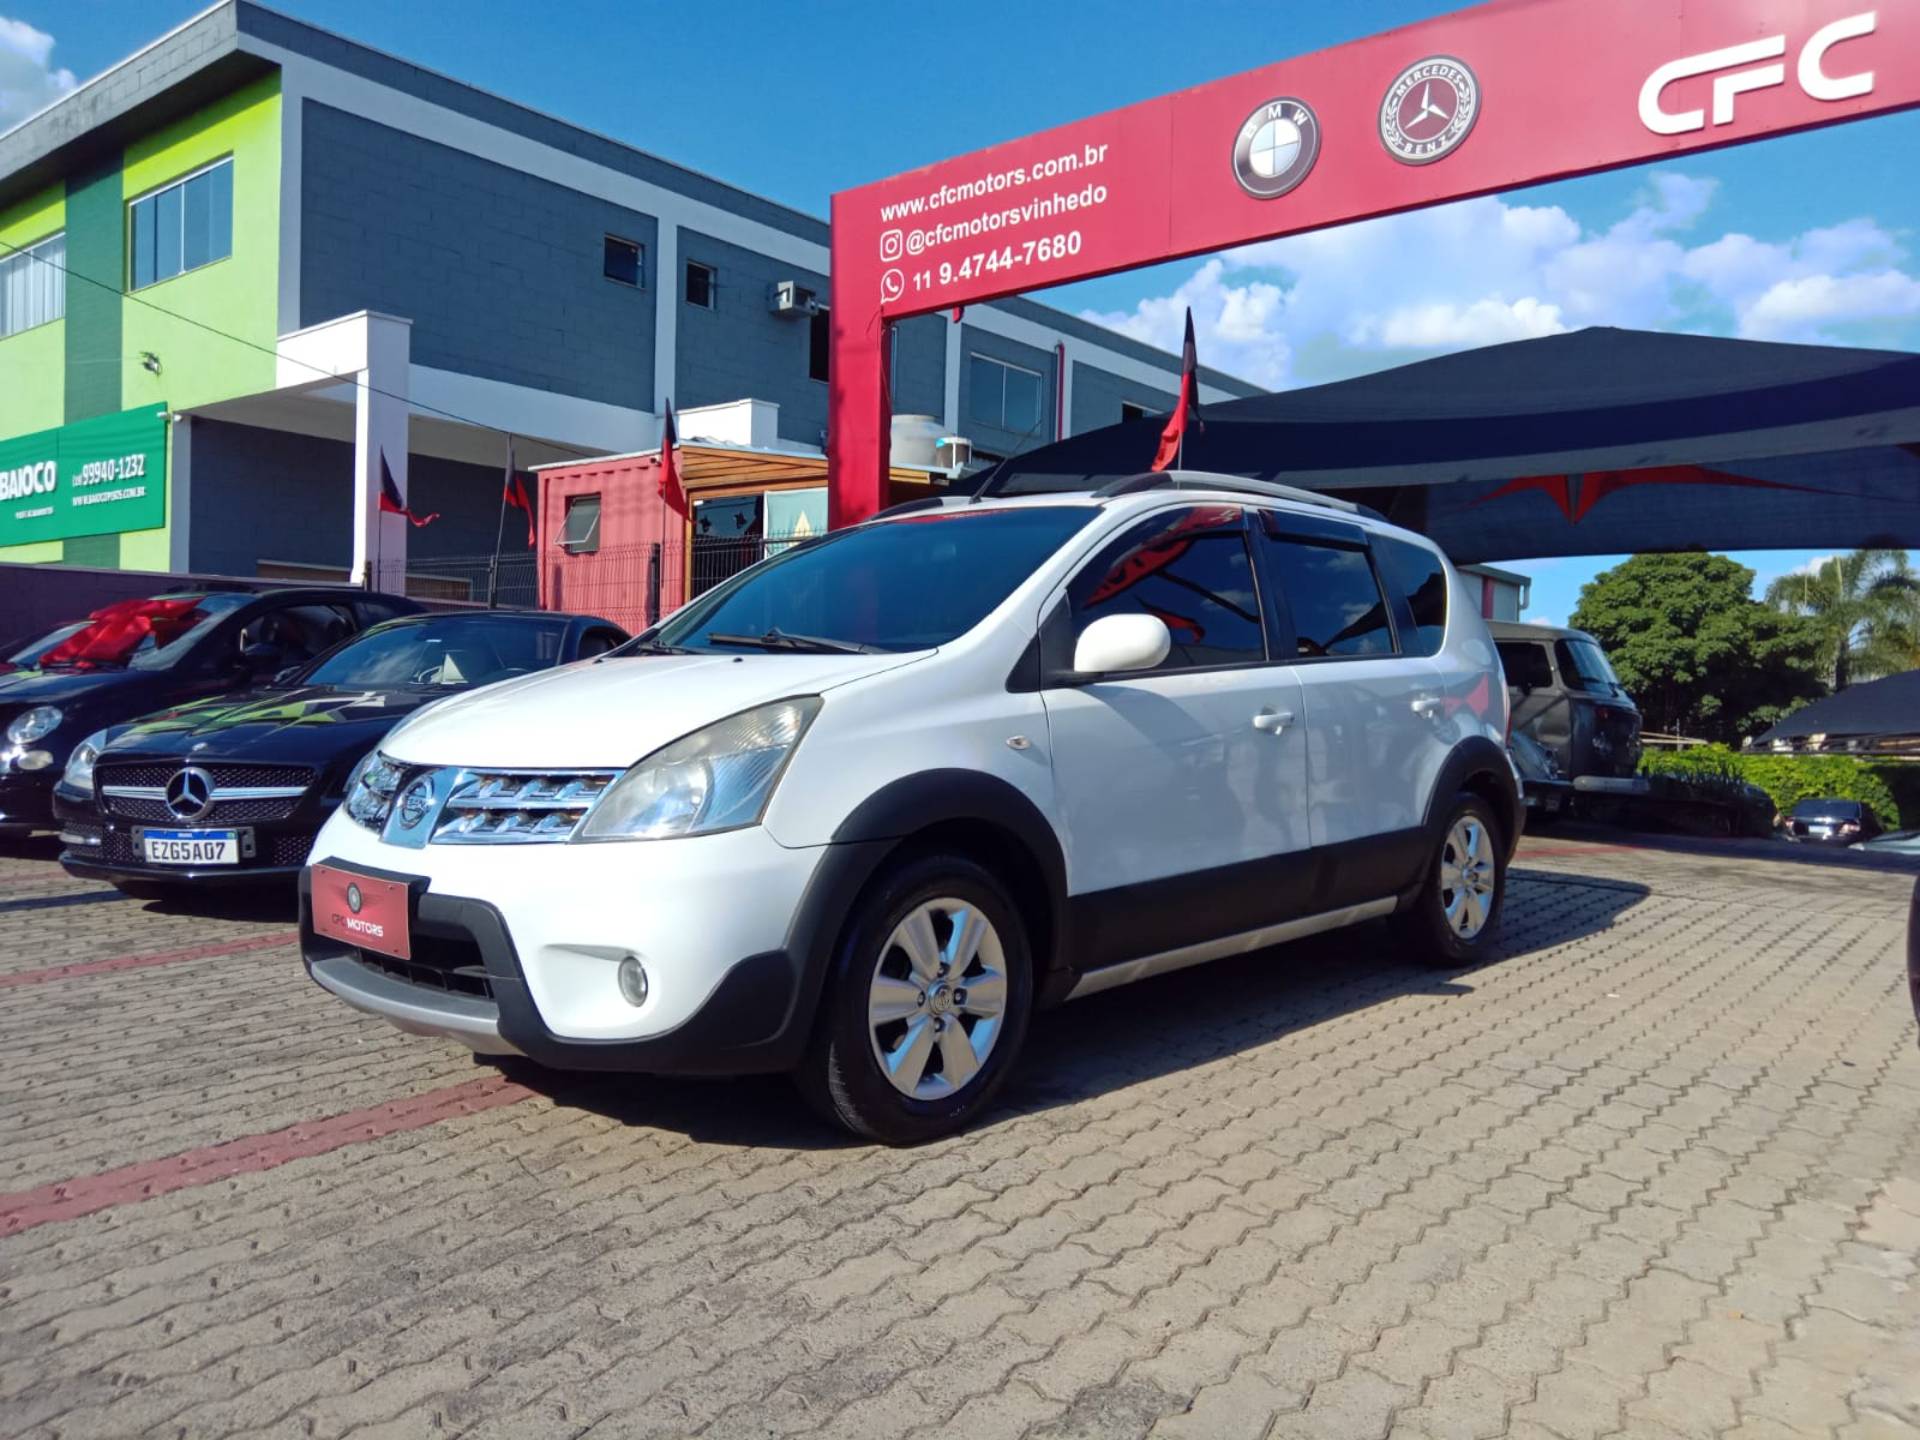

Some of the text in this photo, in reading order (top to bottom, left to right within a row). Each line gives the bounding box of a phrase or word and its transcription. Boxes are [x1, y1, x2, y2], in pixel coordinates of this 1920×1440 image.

[1396, 65, 1462, 97] MERCEDES
[1638, 11, 1876, 134] CFC
[1245, 103, 1308, 137] BMW
[1403, 134, 1450, 154] BENZ
[881, 144, 1108, 222] www.cfcmotors.com.br
[907, 184, 1107, 255] @cfcmotorsvinhedo
[913, 231, 1082, 290] 11 9.4744-7680
[152, 841, 226, 860] EZG5A07
[347, 918, 384, 937] MOTORS
